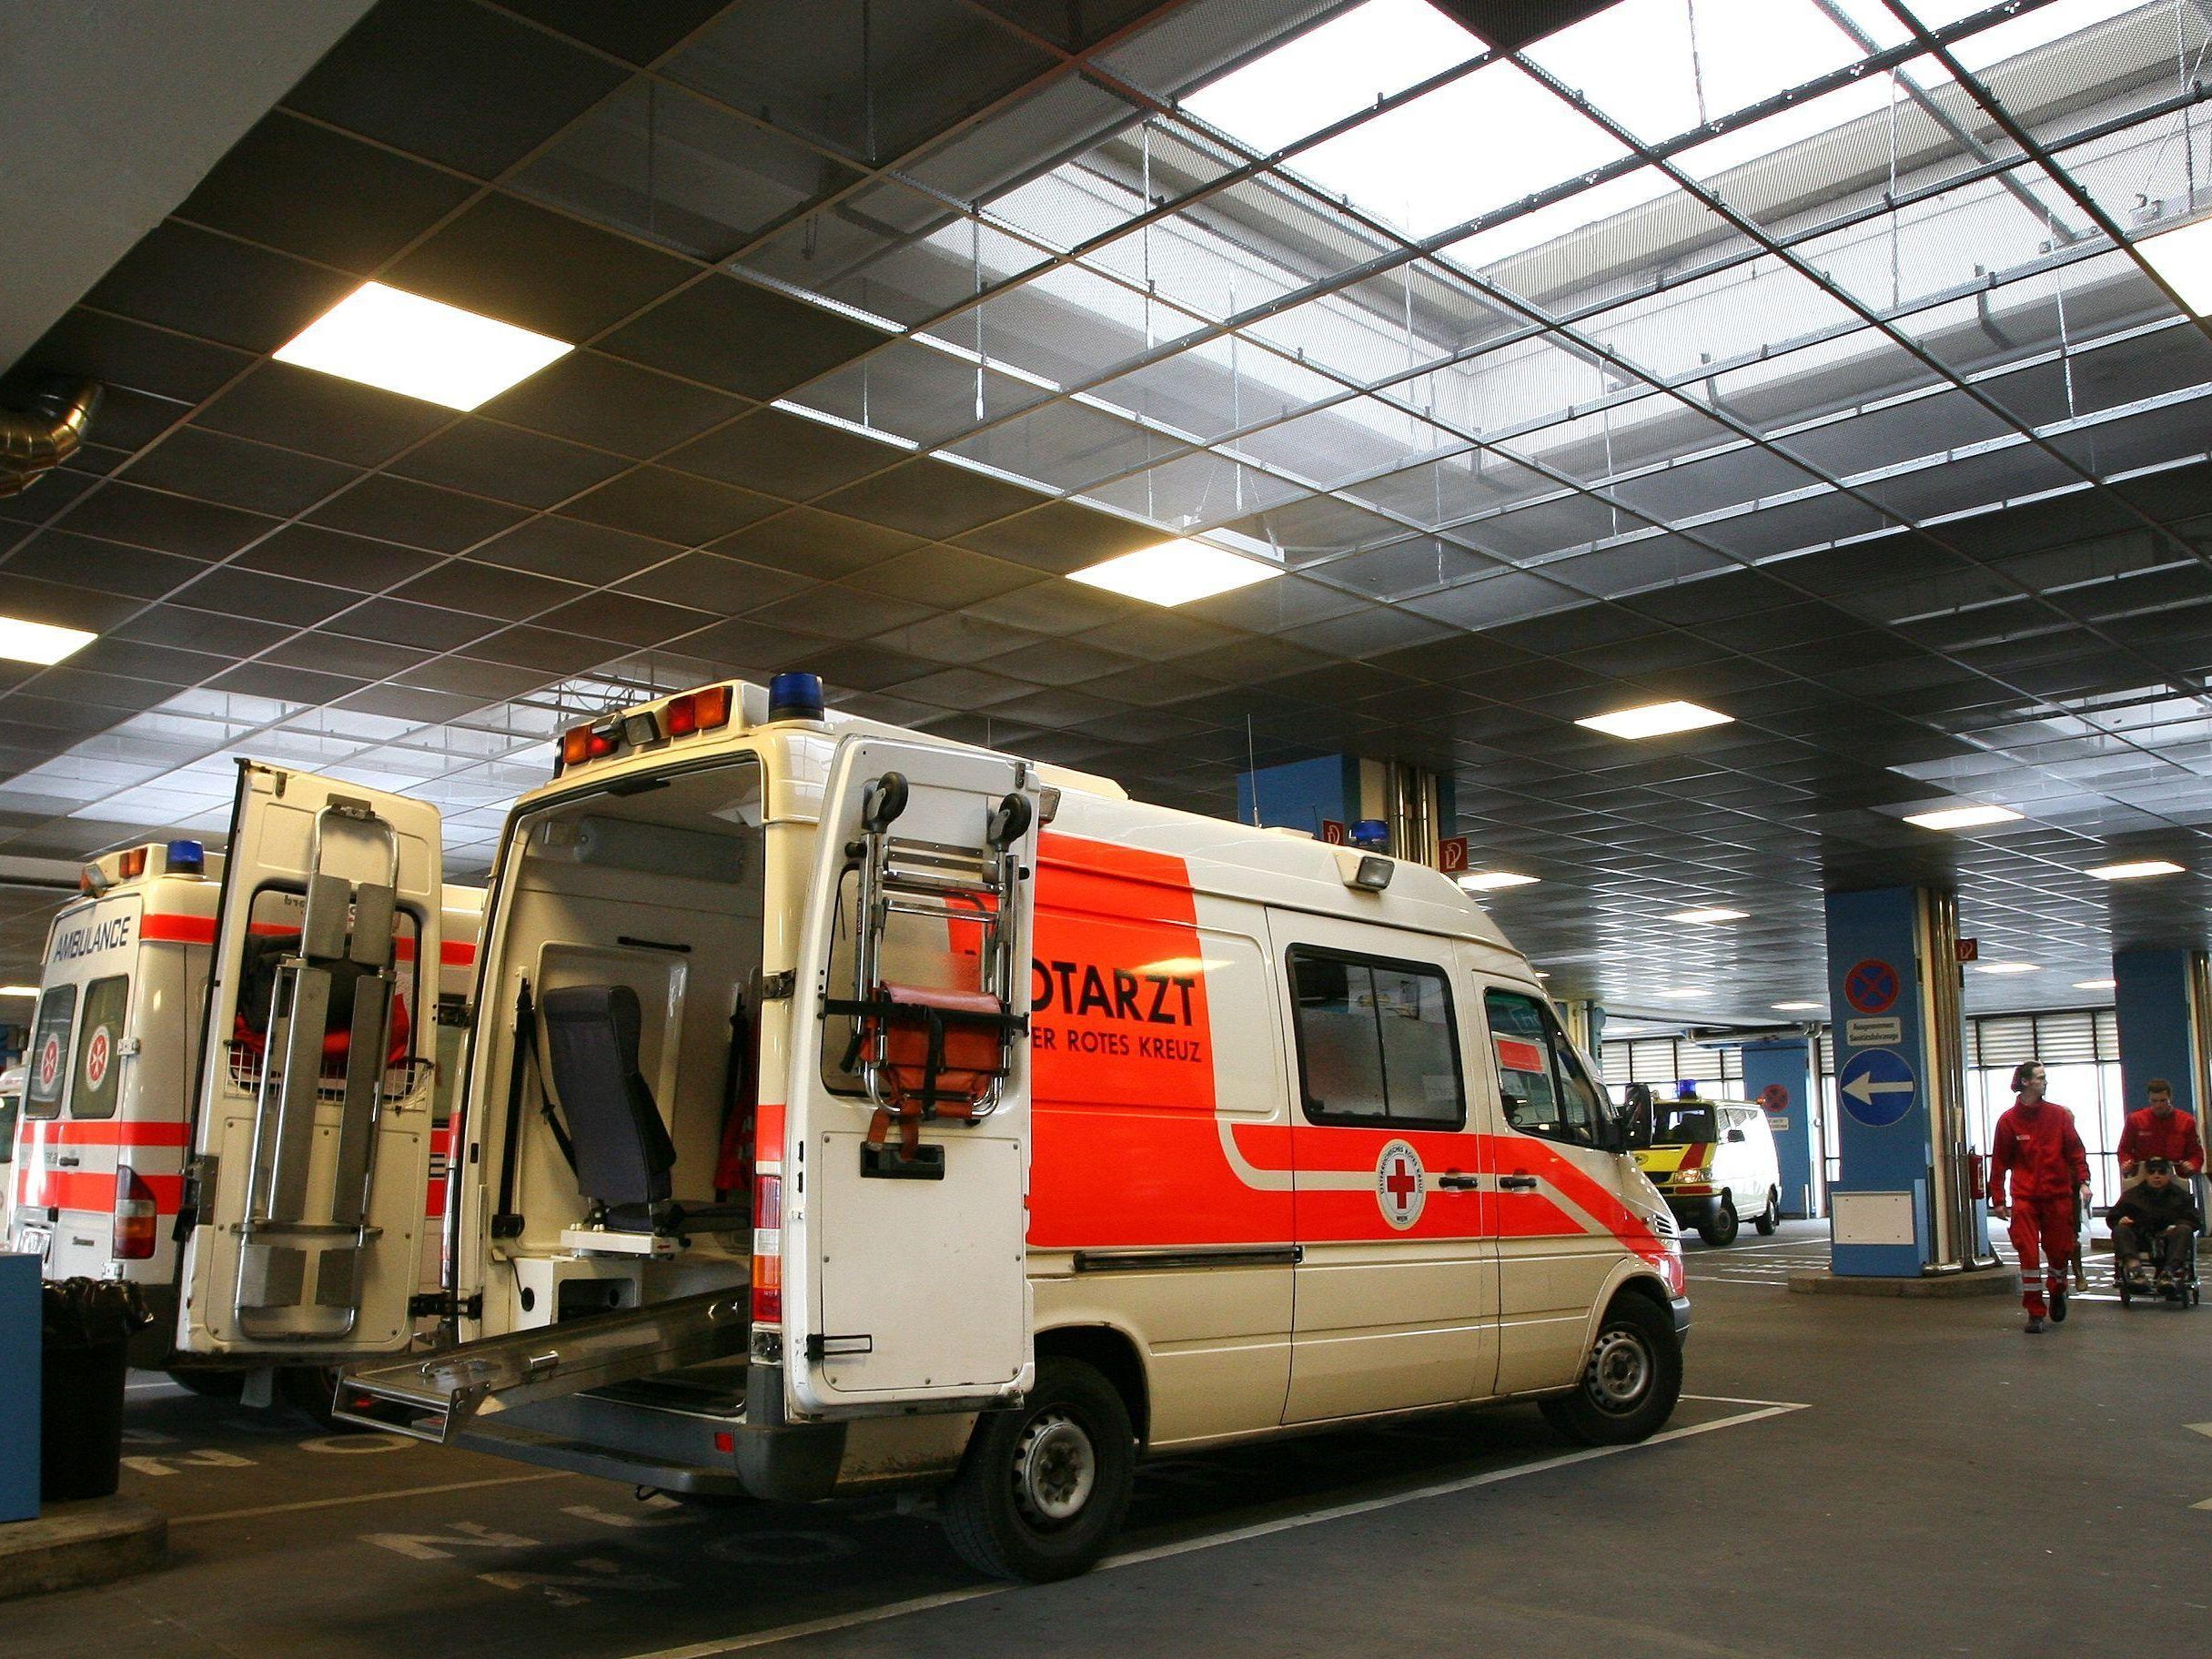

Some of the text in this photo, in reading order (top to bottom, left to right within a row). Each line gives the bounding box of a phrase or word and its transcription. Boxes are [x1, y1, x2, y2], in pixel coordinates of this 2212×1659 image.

[53, 916, 131, 962] AMBULANCE
[1032, 956, 1196, 1026] OTARZT
[1032, 1027, 1202, 1063] ER ROTES KREUZ
